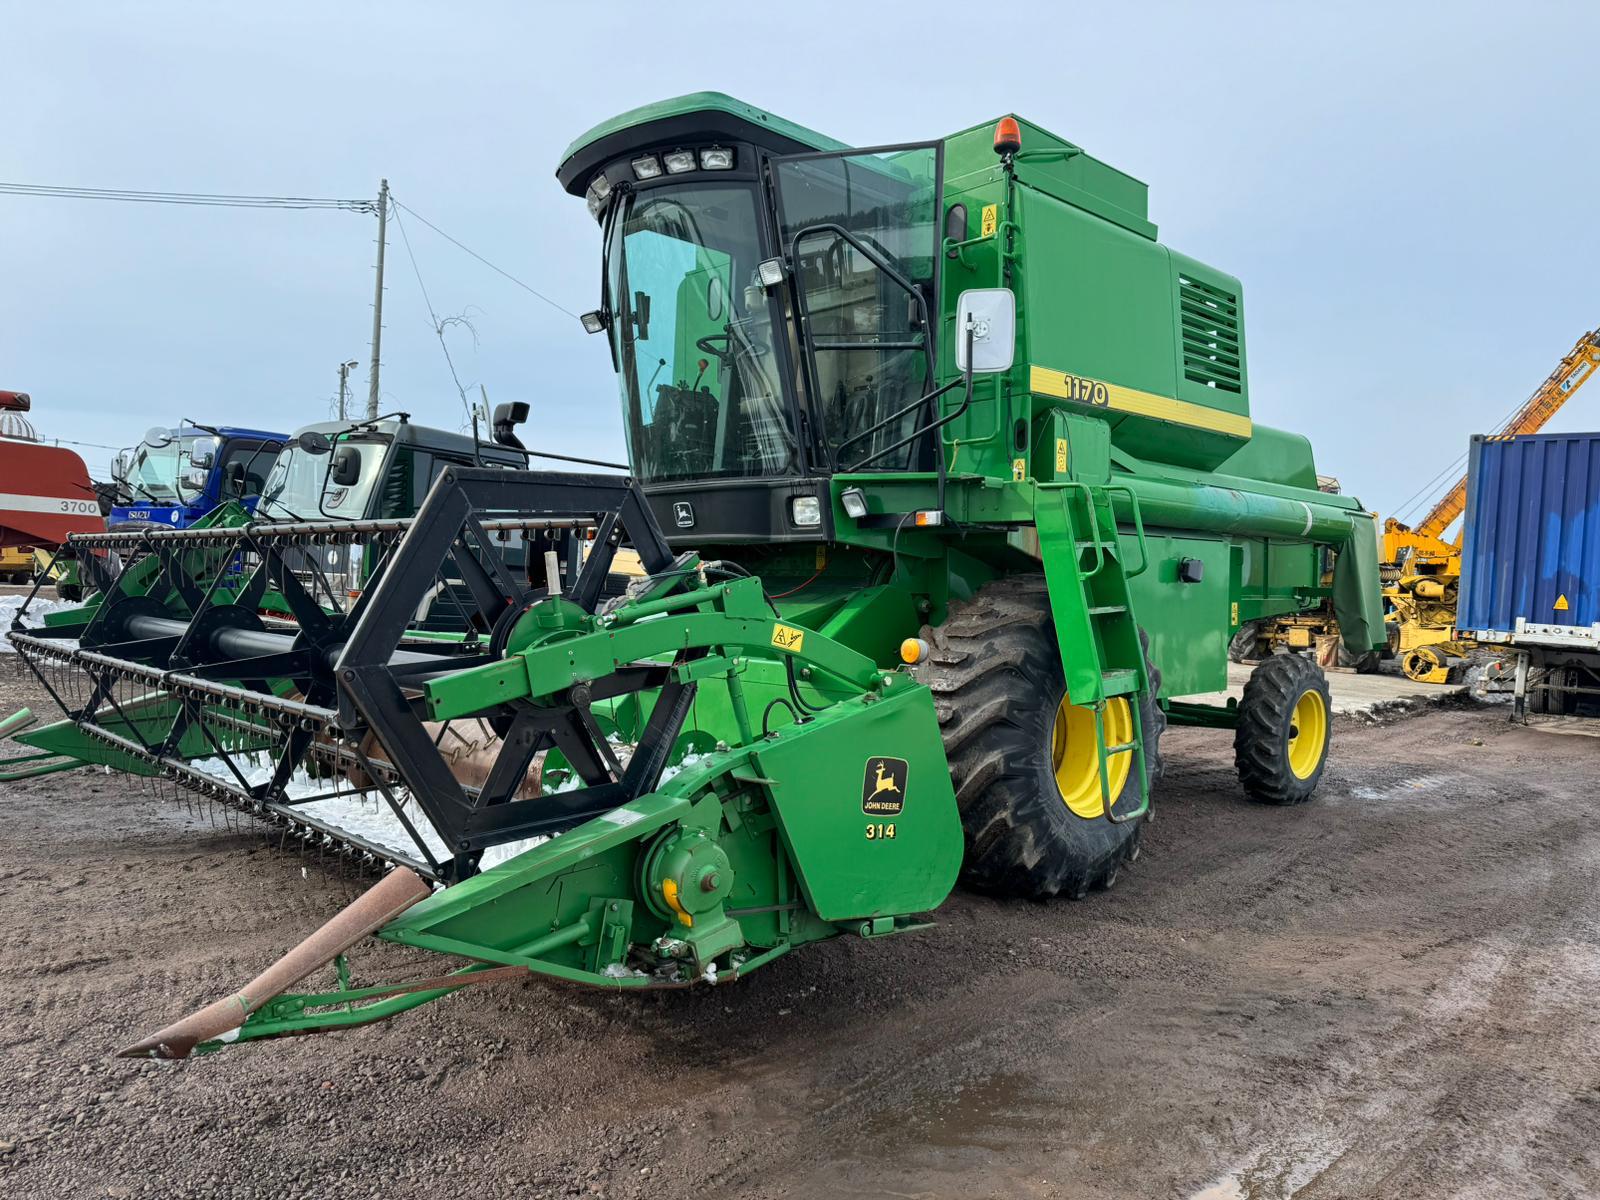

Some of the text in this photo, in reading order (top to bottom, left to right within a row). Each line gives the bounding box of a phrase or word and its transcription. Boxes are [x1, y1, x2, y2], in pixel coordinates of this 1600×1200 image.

[1064, 375, 1108, 407] 1170
[60, 501, 97, 513] 3700
[128, 510, 150, 519] ISUZU
[864, 802, 900, 810] JOHN DEERE
[866, 823, 896, 839] 314
